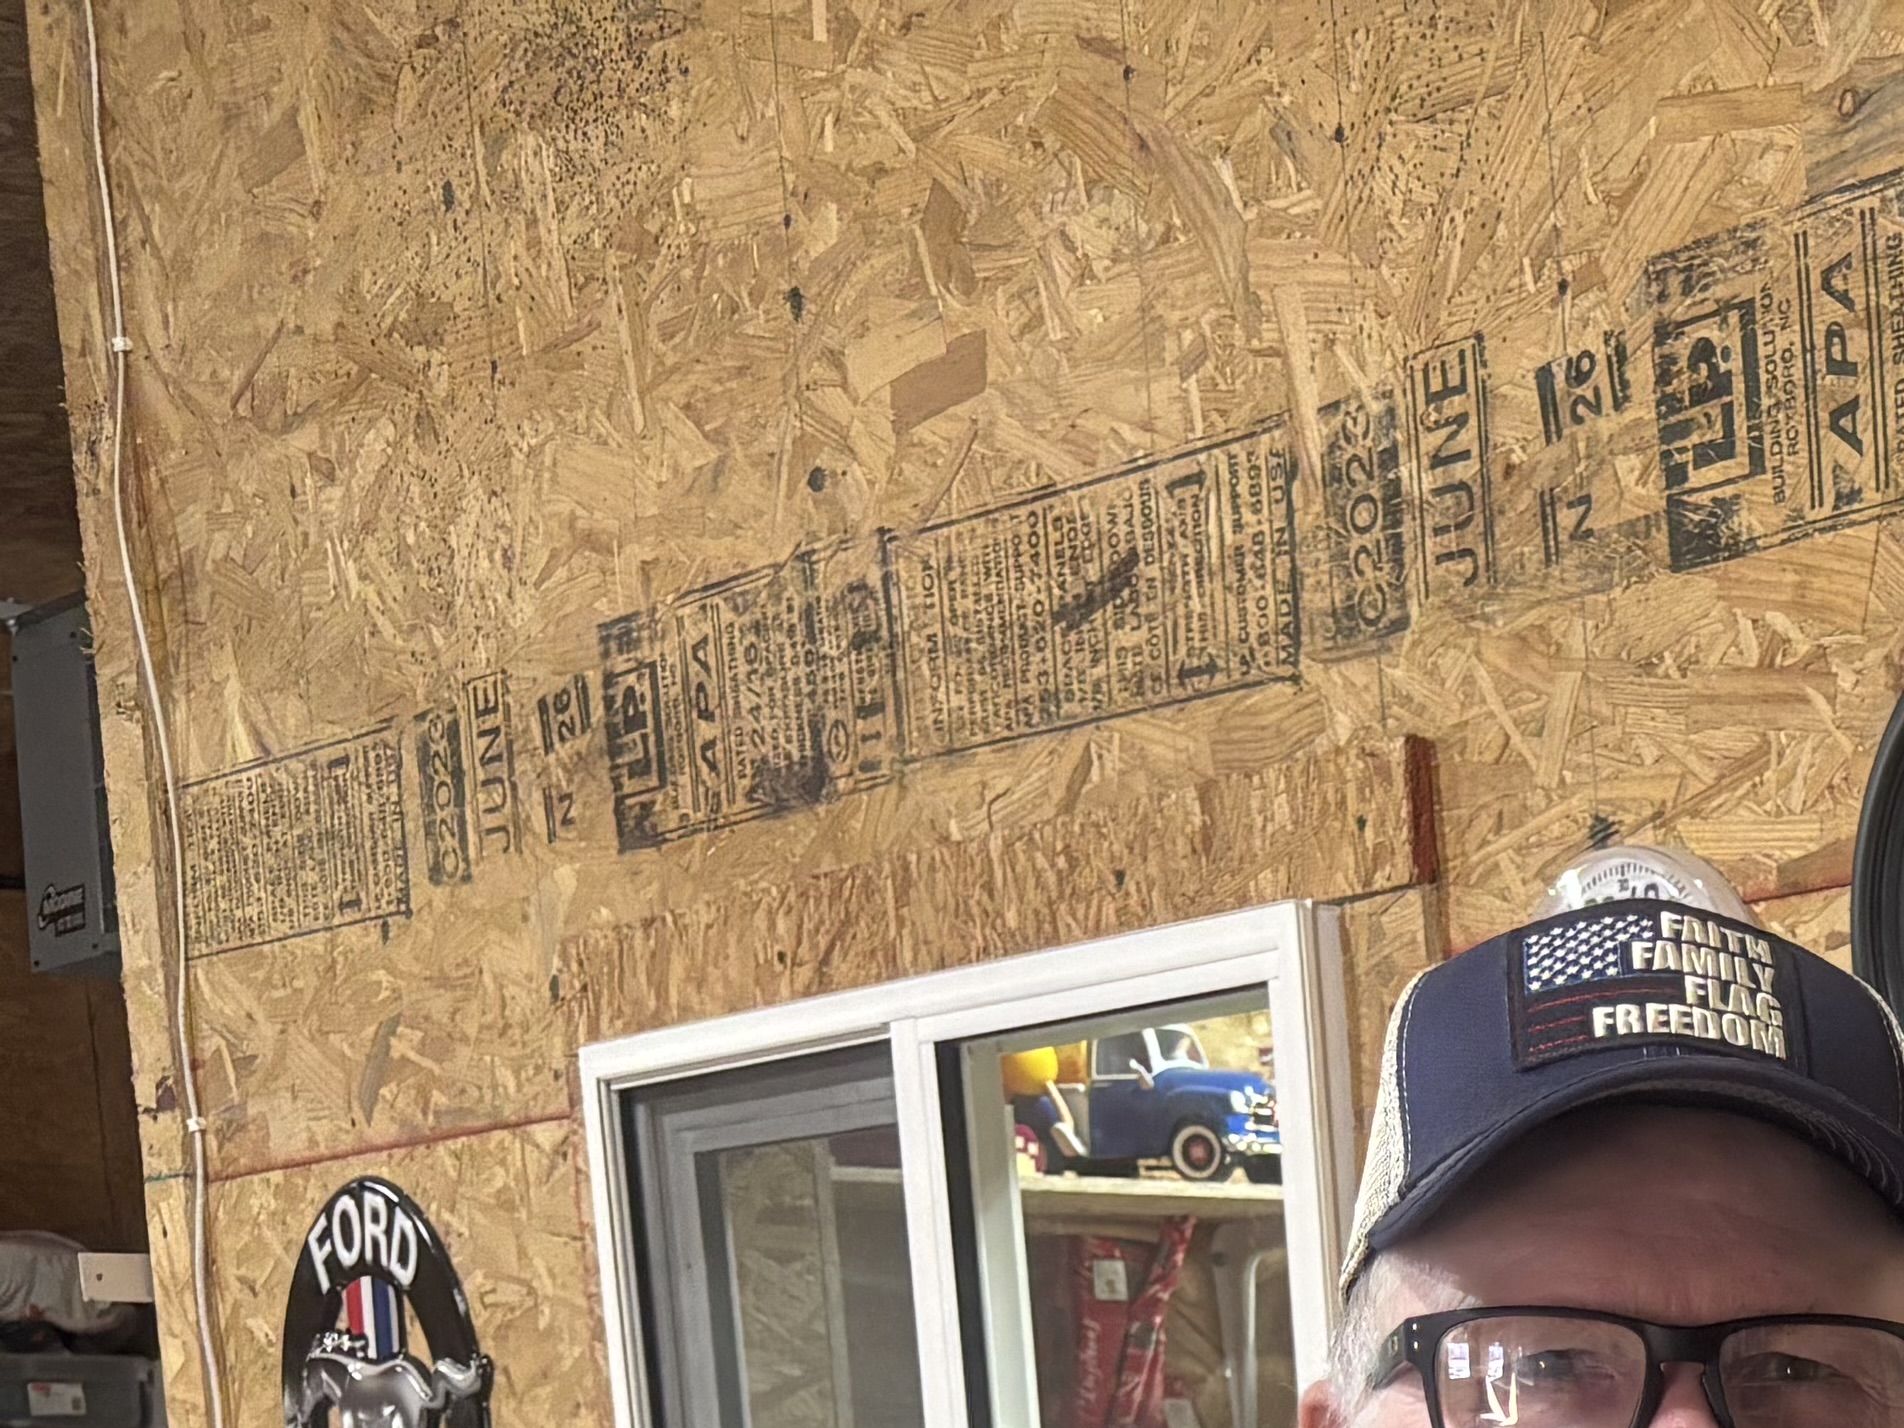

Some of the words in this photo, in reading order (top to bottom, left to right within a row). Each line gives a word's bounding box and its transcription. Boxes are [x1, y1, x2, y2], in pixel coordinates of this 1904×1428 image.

[1564, 349, 1603, 424] 26
[1820, 251, 1863, 456] APA
[1421, 348, 1479, 585] JUNE
[1009, 512, 1025, 591] SUPPOT
[553, 687, 575, 741] 26
[692, 632, 717, 773] APA
[472, 678, 511, 853] JUNE
[1631, 941, 1775, 995] FAMILY
[1659, 912, 1772, 962] FAITH
[1592, 1003, 1787, 1059] FREEDOM
[1685, 976, 1782, 1024] FLAG
[307, 1192, 420, 1294] FORD
